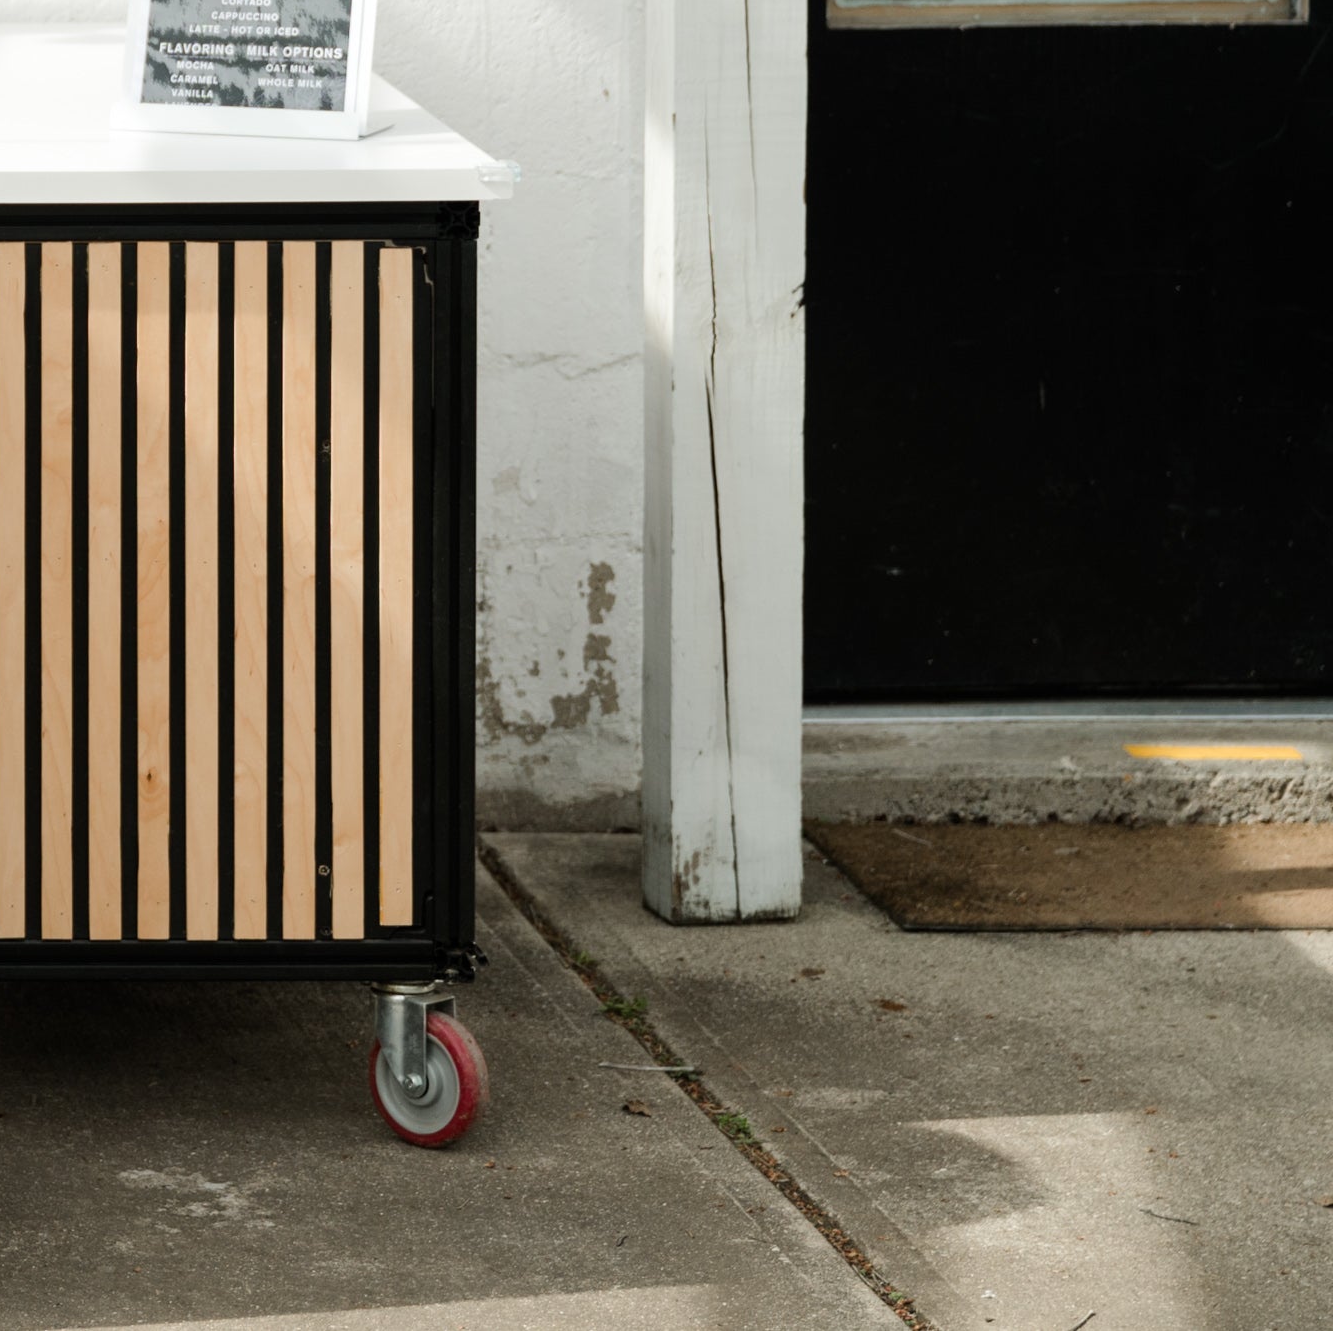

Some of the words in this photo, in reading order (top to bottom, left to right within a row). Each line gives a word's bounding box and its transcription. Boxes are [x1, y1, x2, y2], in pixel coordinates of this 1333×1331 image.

[211, 11, 279, 21] CAPPUCCINO
[189, 24, 220, 34] LATTE
[231, 25, 252, 34] HOT
[256, 26, 271, 35] OR
[274, 26, 300, 36] ICED
[159, 42, 235, 56] FLAVORING
[246, 46, 278, 57] MILK
[282, 47, 343, 59] OPTIONS
[176, 60, 214, 71] MOCHA
[265, 63, 286, 73] OAT
[290, 64, 315, 74] MILK
[170, 75, 218, 85] CARAMEL
[258, 77, 294, 87] WHOLE
[298, 78, 323, 88] MILK
[171, 88, 214, 99] VANILLA
